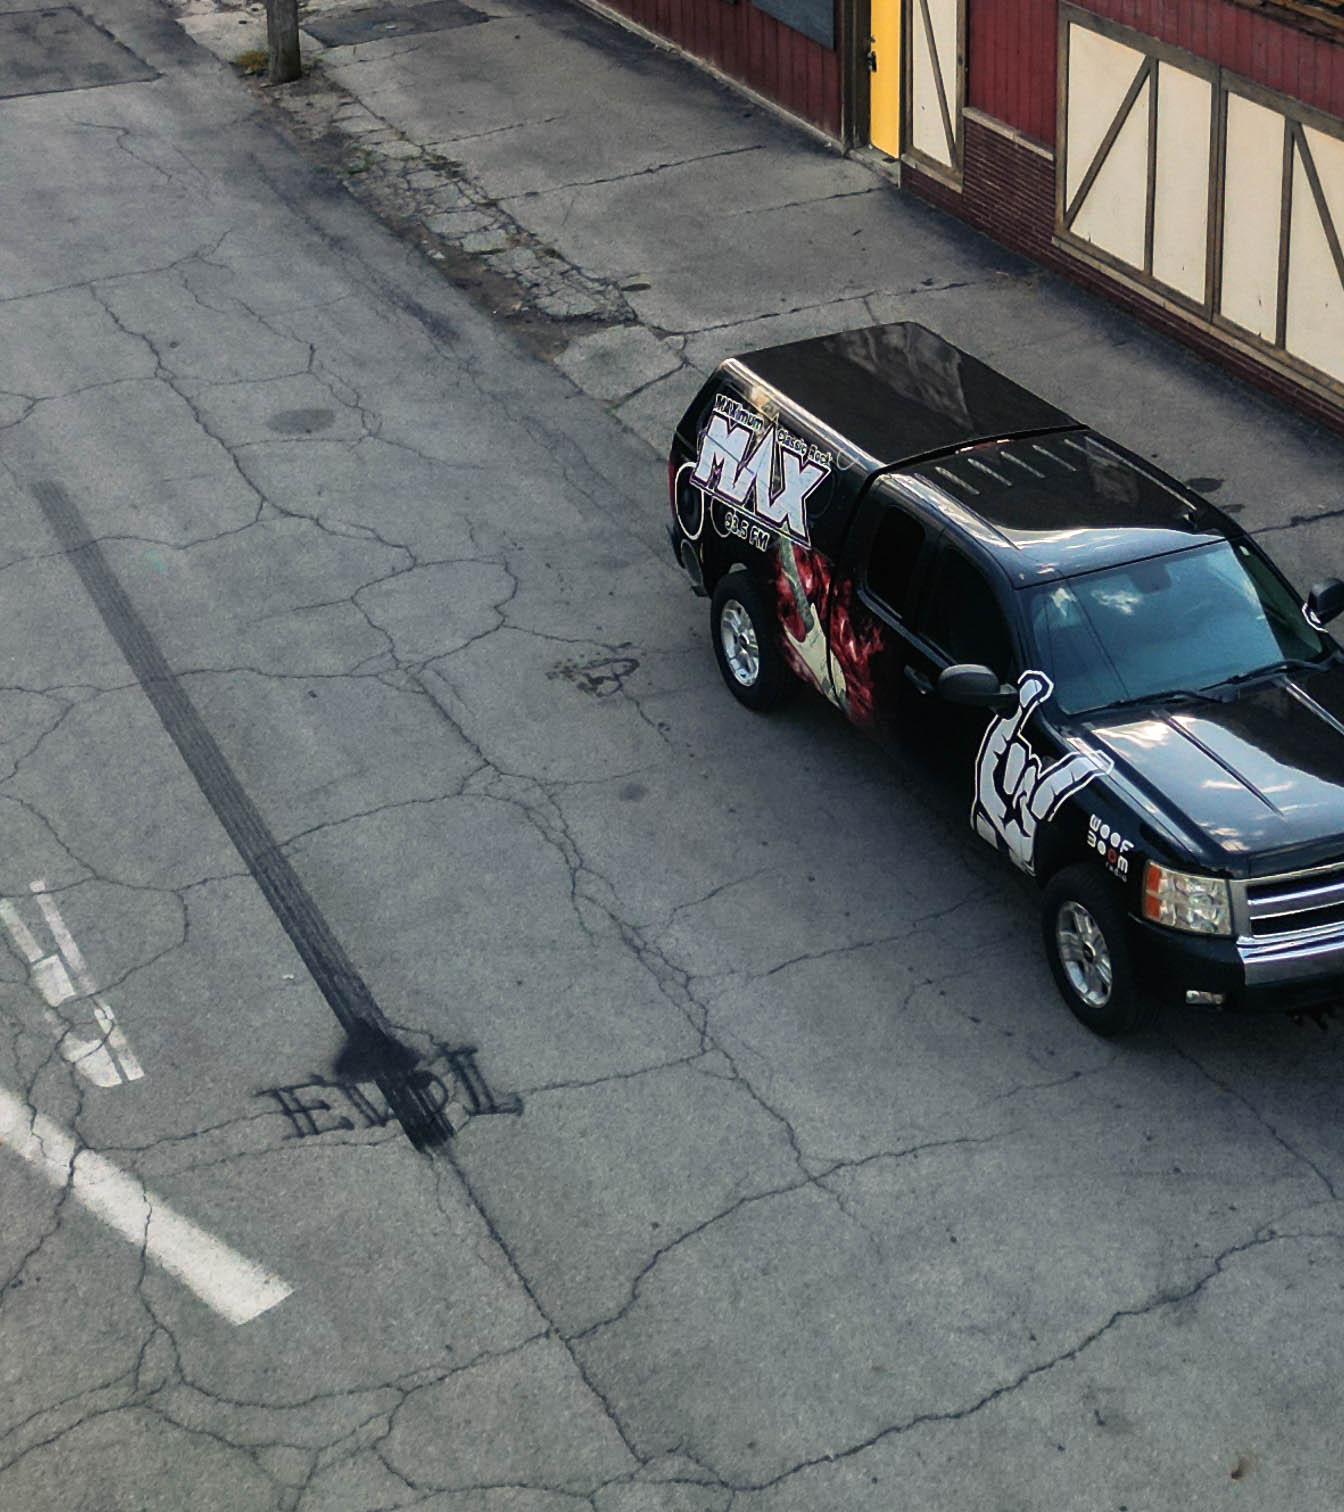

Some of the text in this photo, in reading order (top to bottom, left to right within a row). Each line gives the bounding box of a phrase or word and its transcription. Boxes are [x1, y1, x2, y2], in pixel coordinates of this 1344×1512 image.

[777, 428, 807, 455] Classic
[807, 443, 833, 468] Rock
[689, 412, 832, 550] MAX
[749, 524, 771, 552] FM
